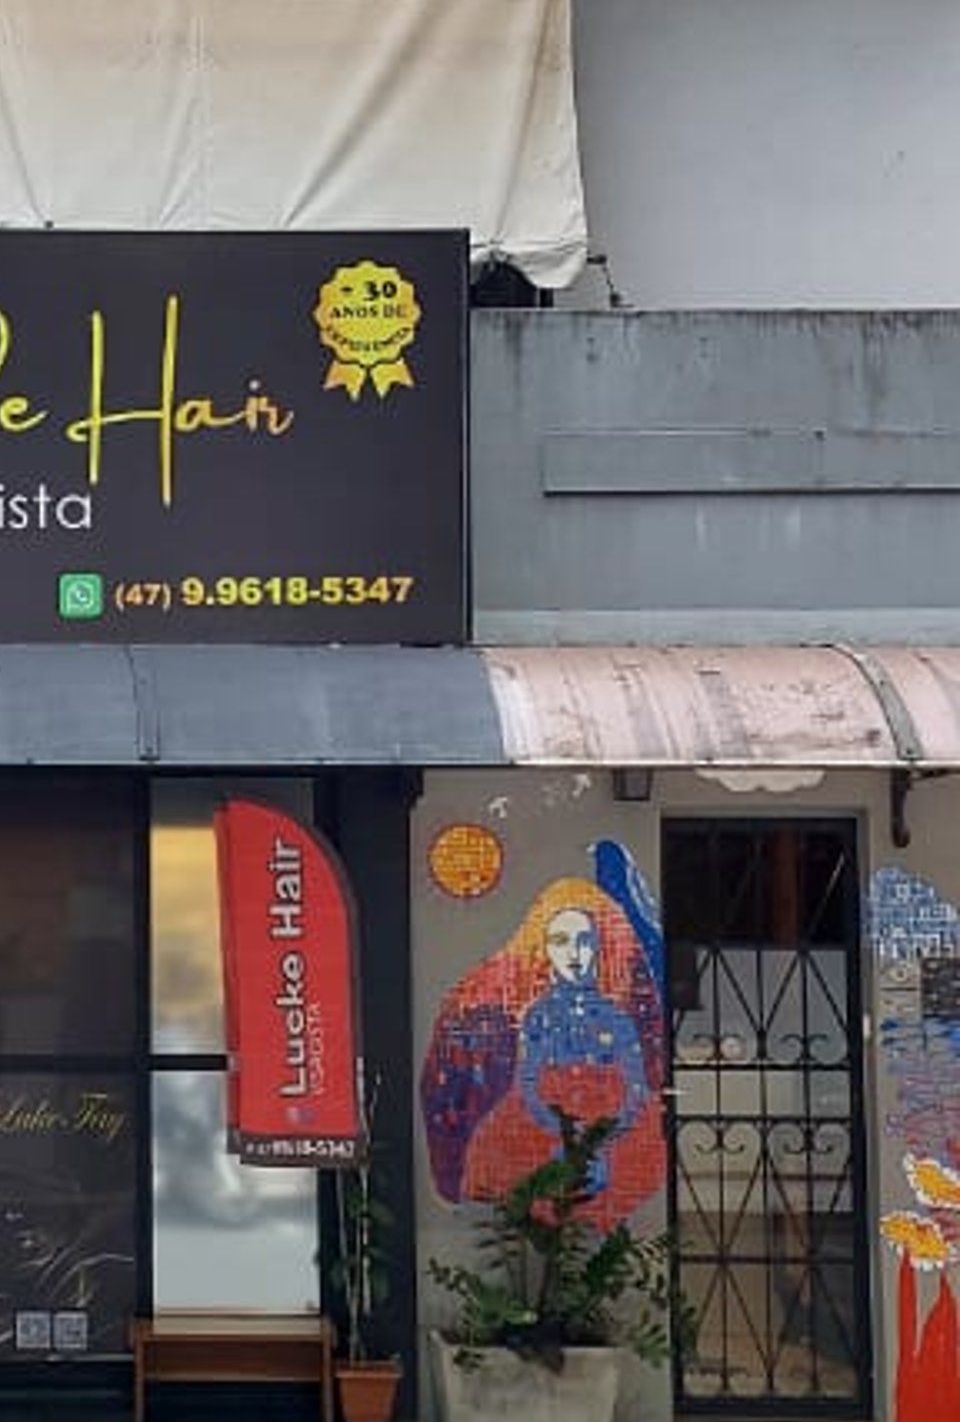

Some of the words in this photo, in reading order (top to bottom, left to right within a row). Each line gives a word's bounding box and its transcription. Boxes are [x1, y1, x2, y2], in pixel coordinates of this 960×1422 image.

[329, 306, 378, 319] ANOS
[362, 280, 398, 301] 30
[65, 295, 294, 506] Hair
[114, 582, 172, 611] (47)
[181, 576, 413, 605] 9.9618-5347
[268, 837, 303, 938] Hair
[274, 952, 308, 1098] Lucke
